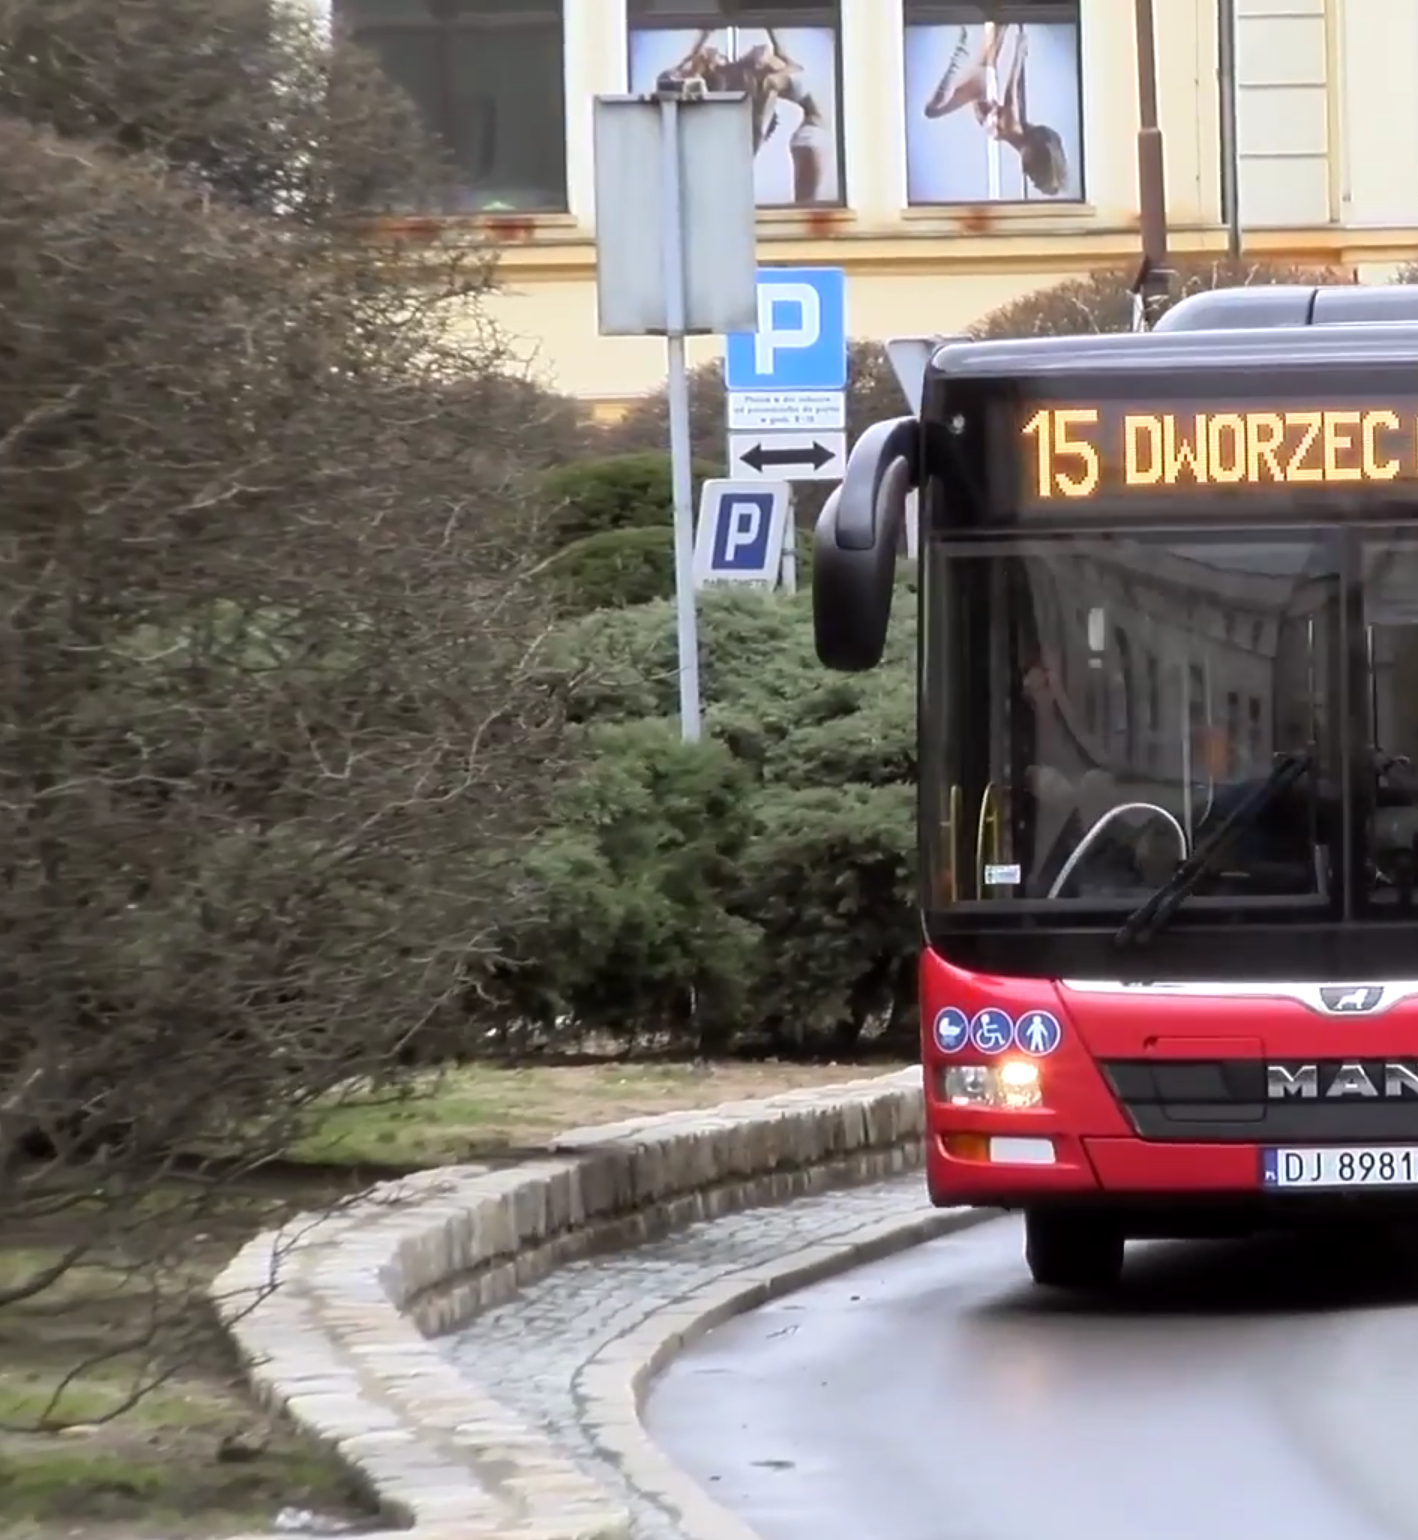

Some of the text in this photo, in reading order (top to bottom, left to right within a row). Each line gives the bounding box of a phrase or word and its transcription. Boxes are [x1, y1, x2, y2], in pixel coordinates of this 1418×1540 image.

[755, 283, 820, 375] P
[1021, 408, 1099, 497] 15
[1124, 410, 1400, 485] DWORZEC
[724, 502, 761, 562] P
[1285, 1152, 1322, 1182] DJ
